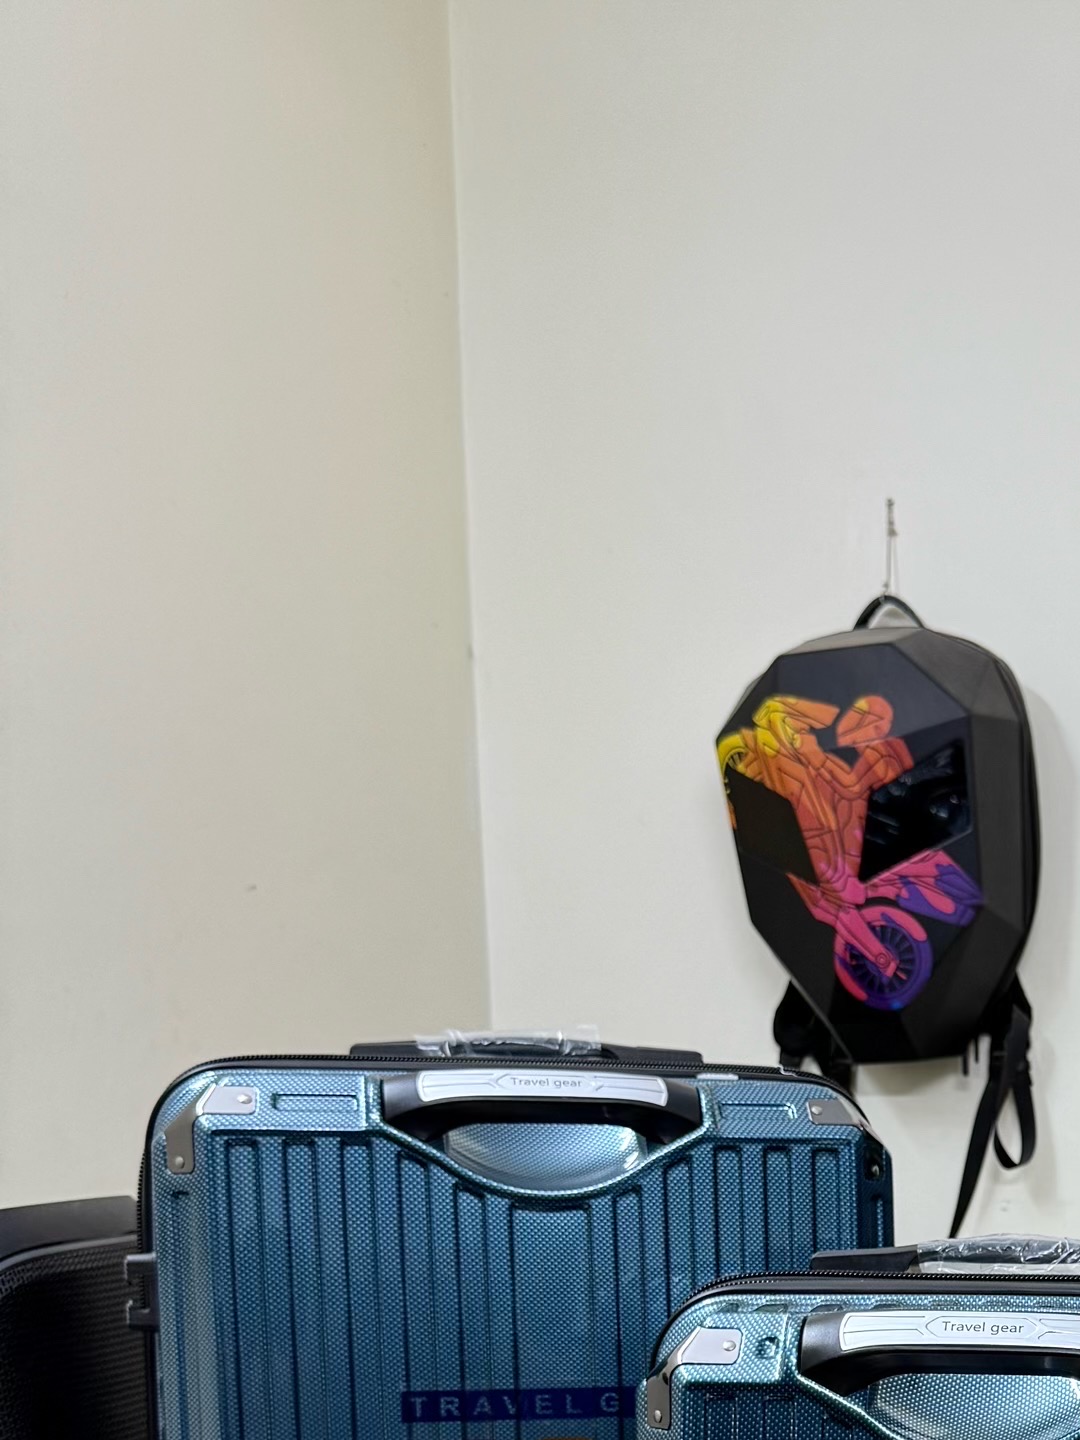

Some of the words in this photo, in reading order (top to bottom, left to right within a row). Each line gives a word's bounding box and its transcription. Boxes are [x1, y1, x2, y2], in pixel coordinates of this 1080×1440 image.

[510, 1077, 550, 1087] Travel
[553, 1079, 583, 1089] gear
[942, 1320, 986, 1334] Travel
[990, 1323, 1025, 1336] gear
[411, 1394, 583, 1418] TRAVEL
